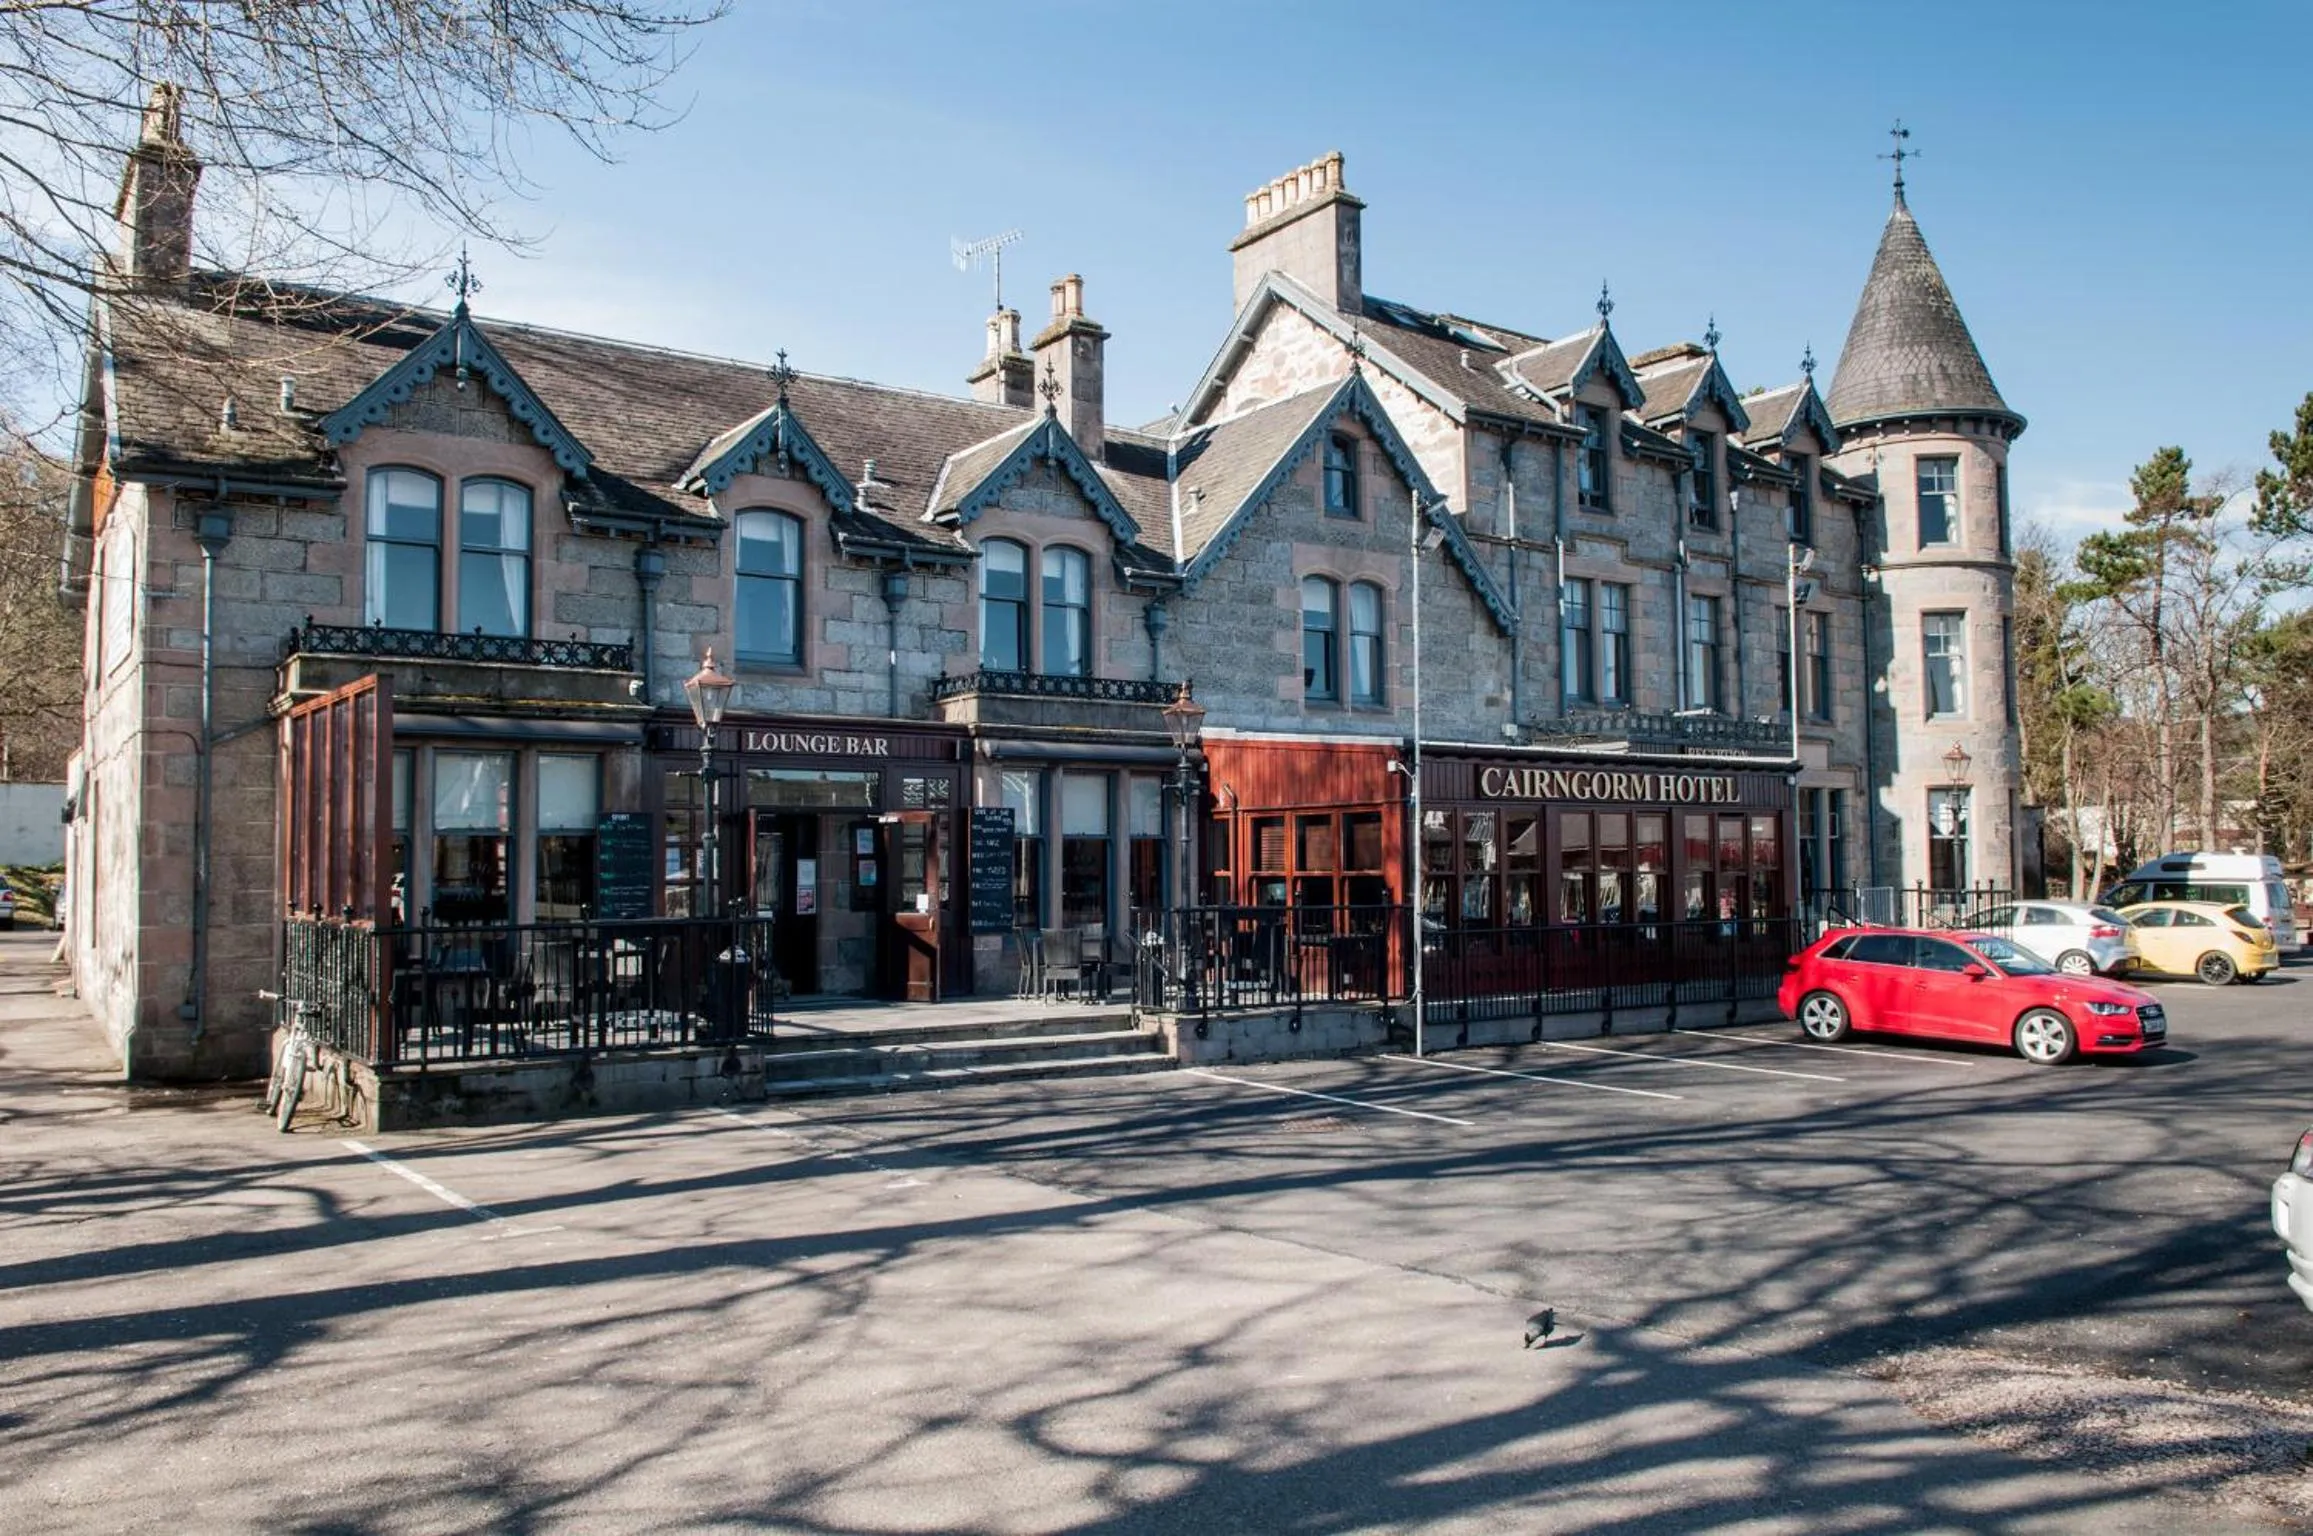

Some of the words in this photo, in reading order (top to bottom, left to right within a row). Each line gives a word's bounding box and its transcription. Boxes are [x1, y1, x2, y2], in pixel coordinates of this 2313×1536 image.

[747, 732, 840, 753] LOUNGE
[846, 736, 888, 756] BAR
[1481, 767, 1652, 801] CAIRNGORM
[1658, 775, 1740, 803] HOTEL
